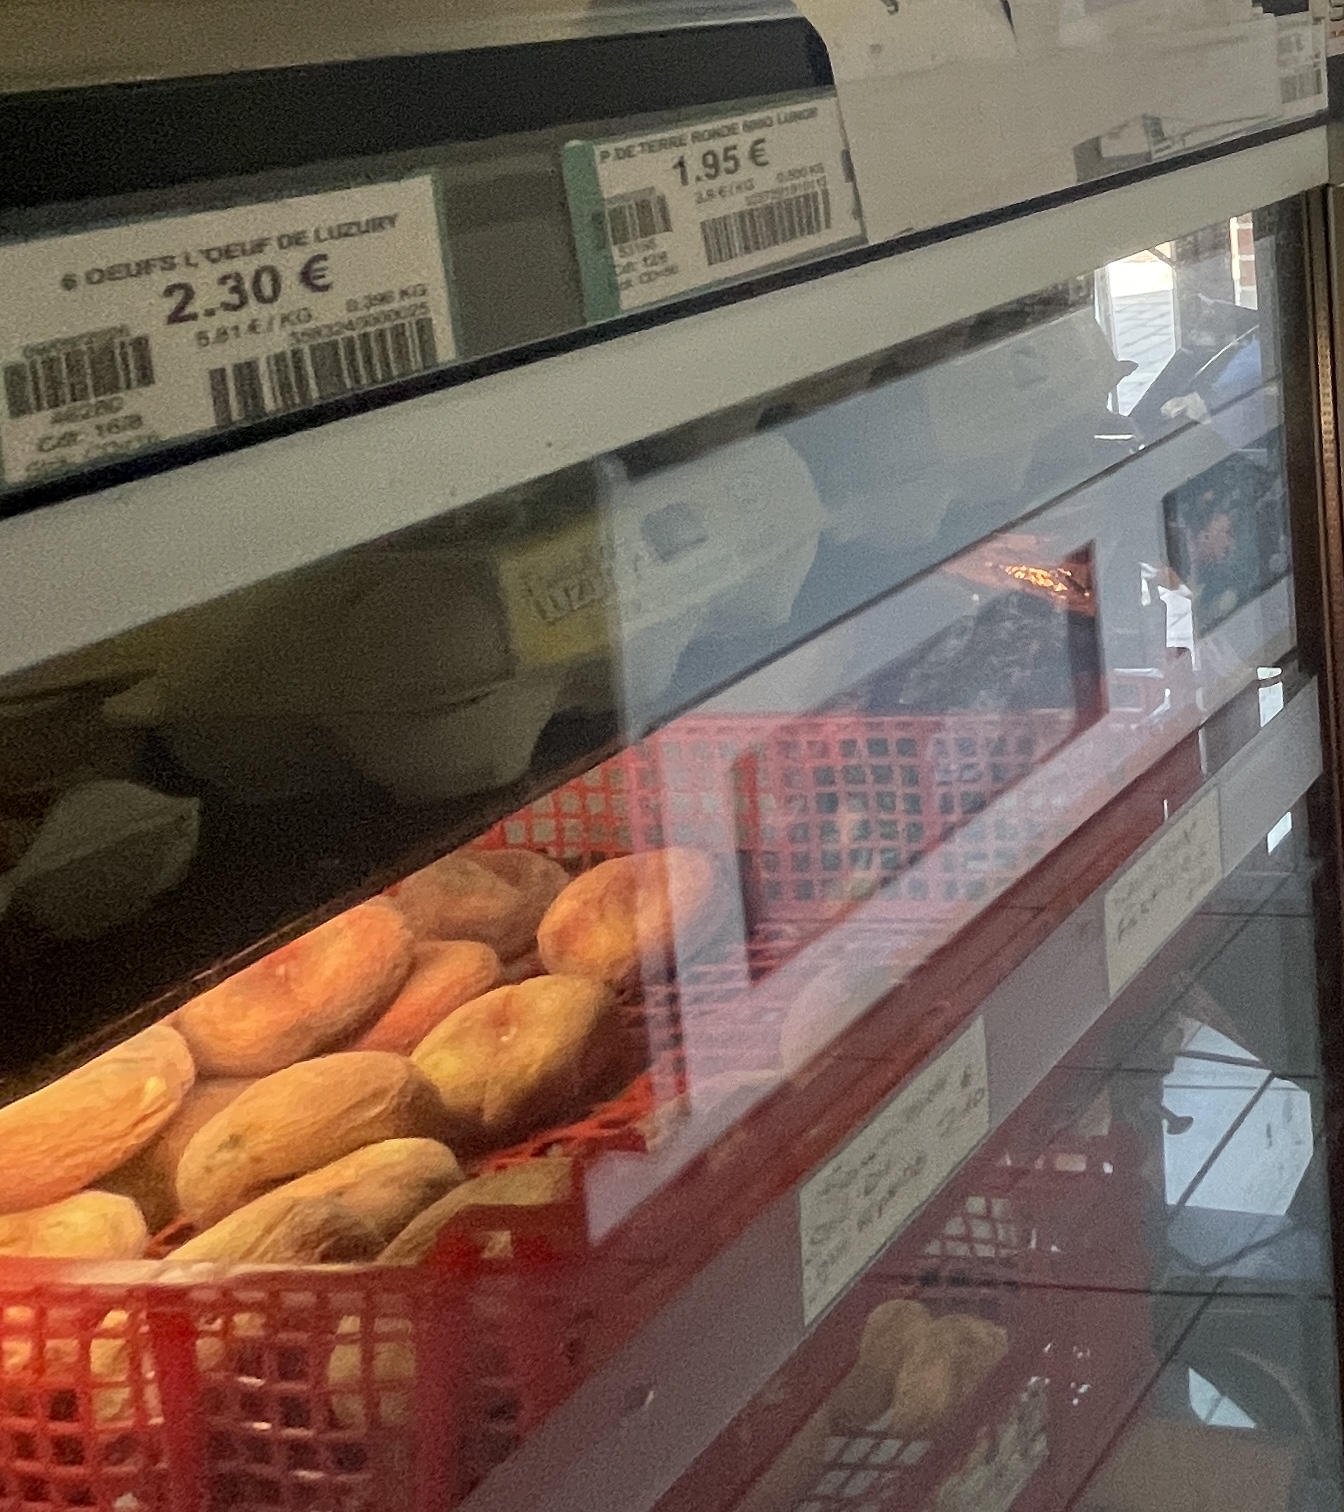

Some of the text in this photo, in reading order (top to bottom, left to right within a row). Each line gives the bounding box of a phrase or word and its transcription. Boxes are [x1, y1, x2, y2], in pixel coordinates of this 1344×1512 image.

[671, 143, 741, 187] 1.95
[84, 252, 177, 286] OEUFS
[277, 229, 310, 250] DE
[162, 252, 335, 326] 2.30 €
